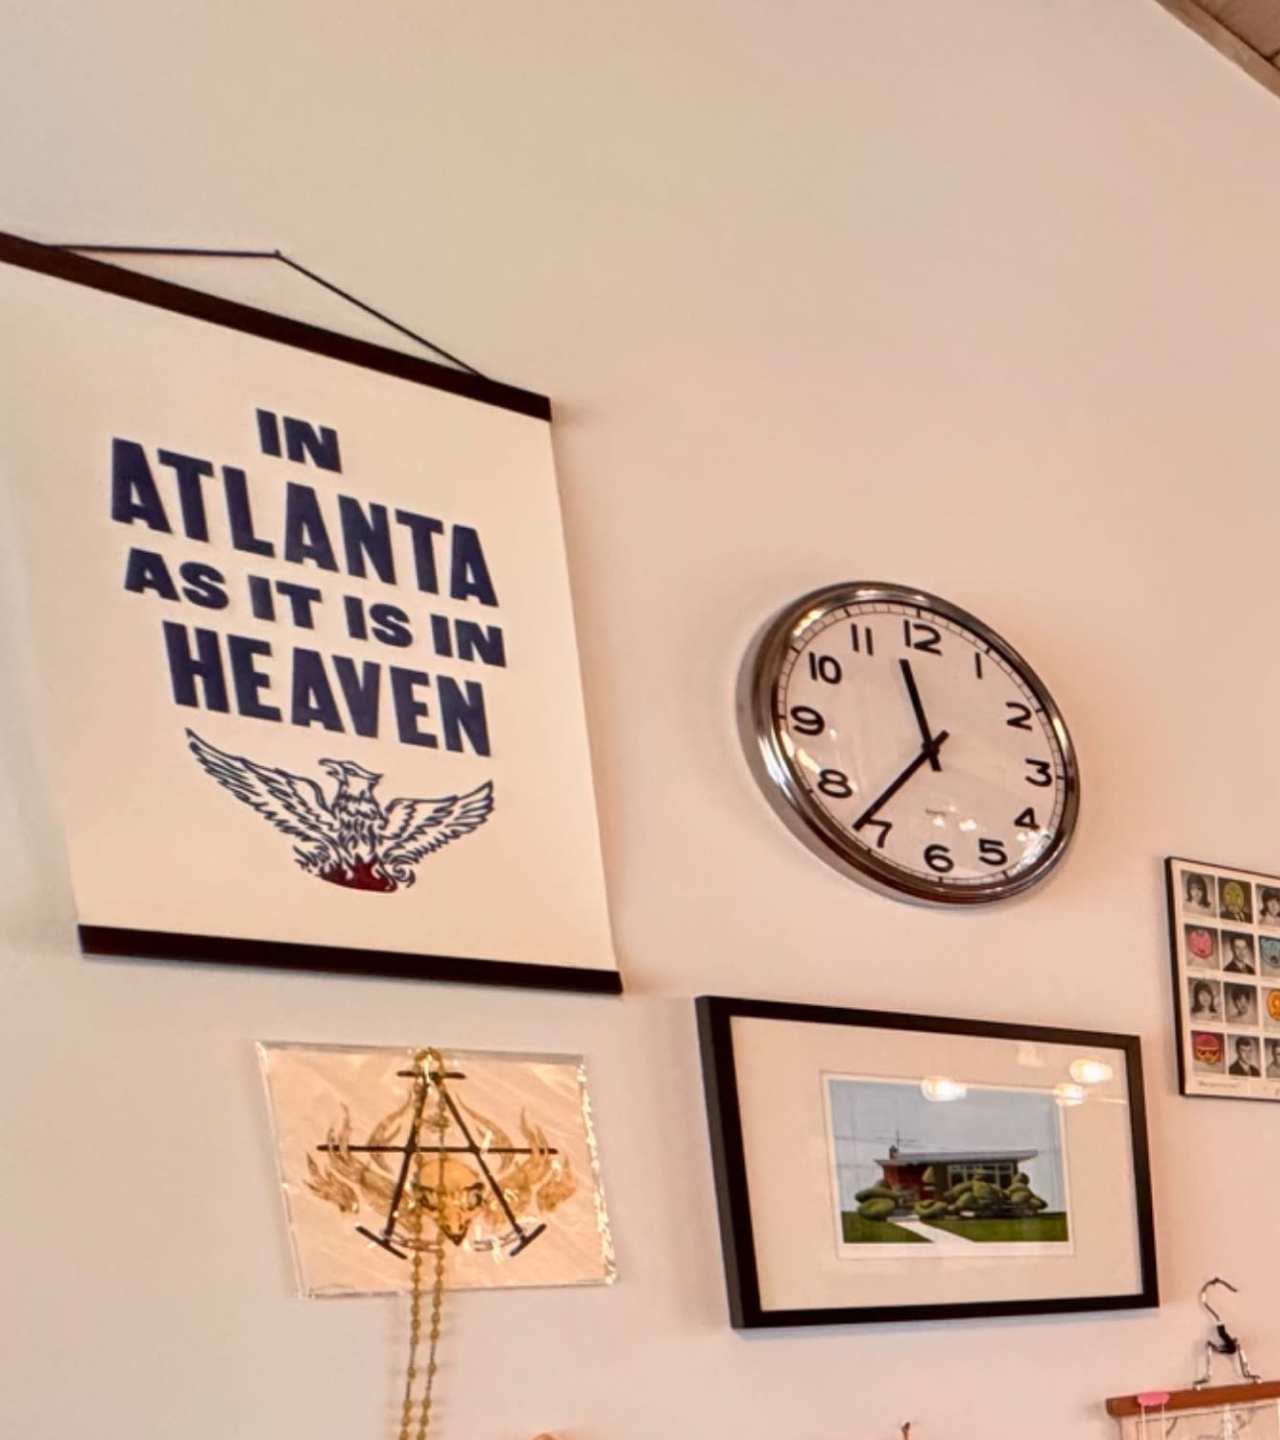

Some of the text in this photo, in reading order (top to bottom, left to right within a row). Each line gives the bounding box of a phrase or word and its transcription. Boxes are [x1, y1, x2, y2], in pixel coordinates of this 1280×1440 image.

[256, 408, 342, 474] IN
[111, 437, 500, 607] ATLANTA
[124, 547, 507, 667] AS IT IS IN
[851, 623, 873, 656] 11
[903, 620, 942, 656] 12
[808, 651, 842, 684] 10
[975, 651, 982, 679] 1
[163, 620, 492, 757] HEAVEN
[790, 705, 825, 735] 9
[1005, 701, 1033, 731] 2
[817, 769, 852, 799] 8
[1025, 758, 1052, 787] 3
[865, 817, 893, 848] 7
[1014, 807, 1040, 830] 4
[923, 844, 955, 873] 6
[978, 838, 1008, 866] 5
